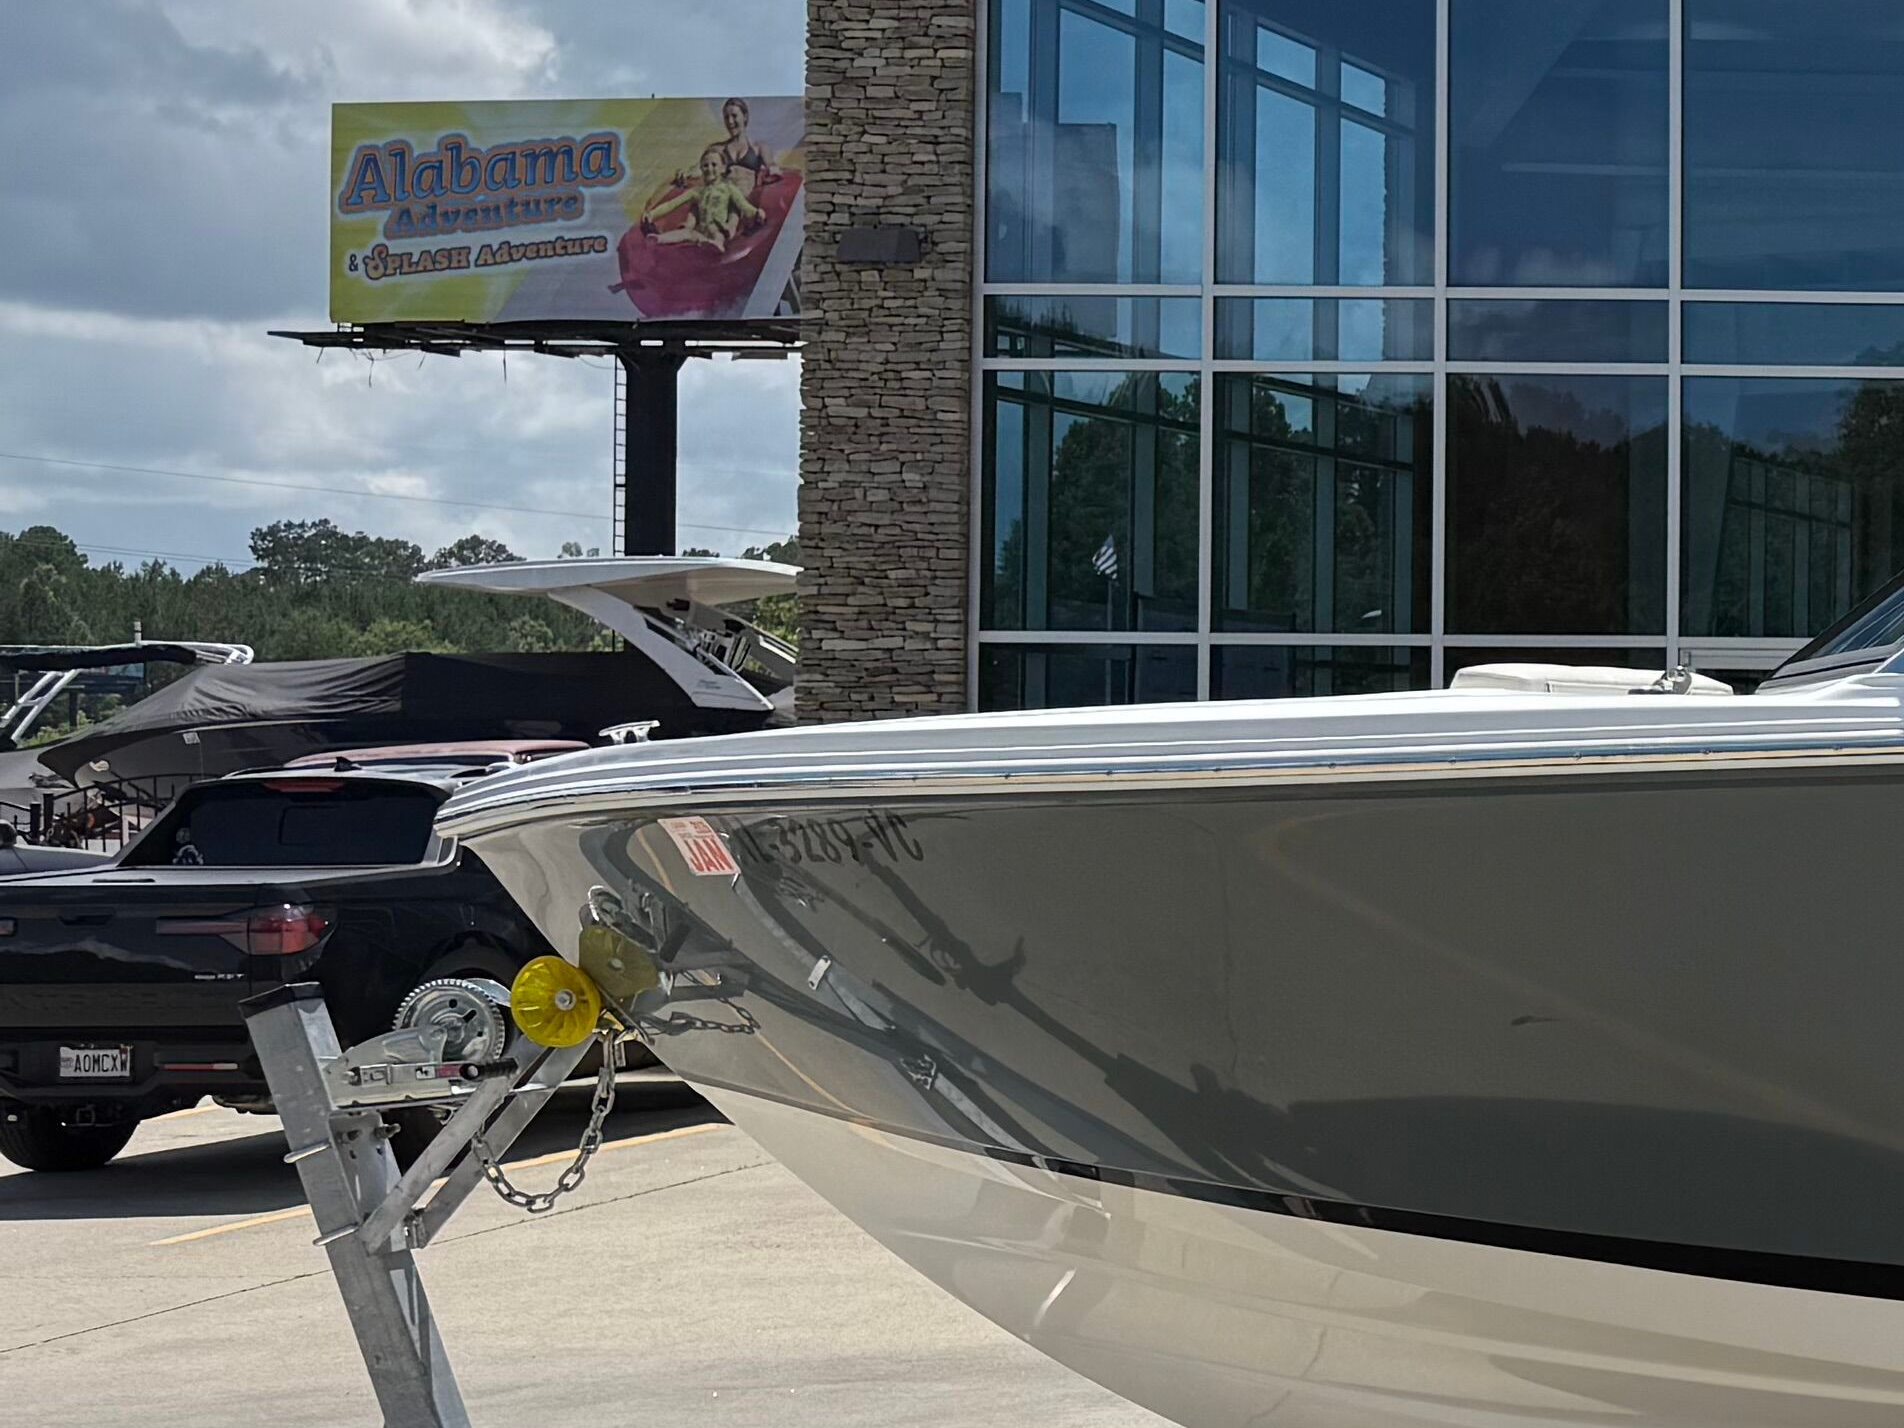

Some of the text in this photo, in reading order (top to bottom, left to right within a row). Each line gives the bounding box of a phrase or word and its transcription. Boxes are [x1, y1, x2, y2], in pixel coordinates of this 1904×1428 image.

[347, 140, 617, 205] Alabama
[394, 194, 579, 234] Adventure
[348, 254, 359, 272] &
[475, 234, 607, 265] Adventure
[684, 839, 734, 872] JAN
